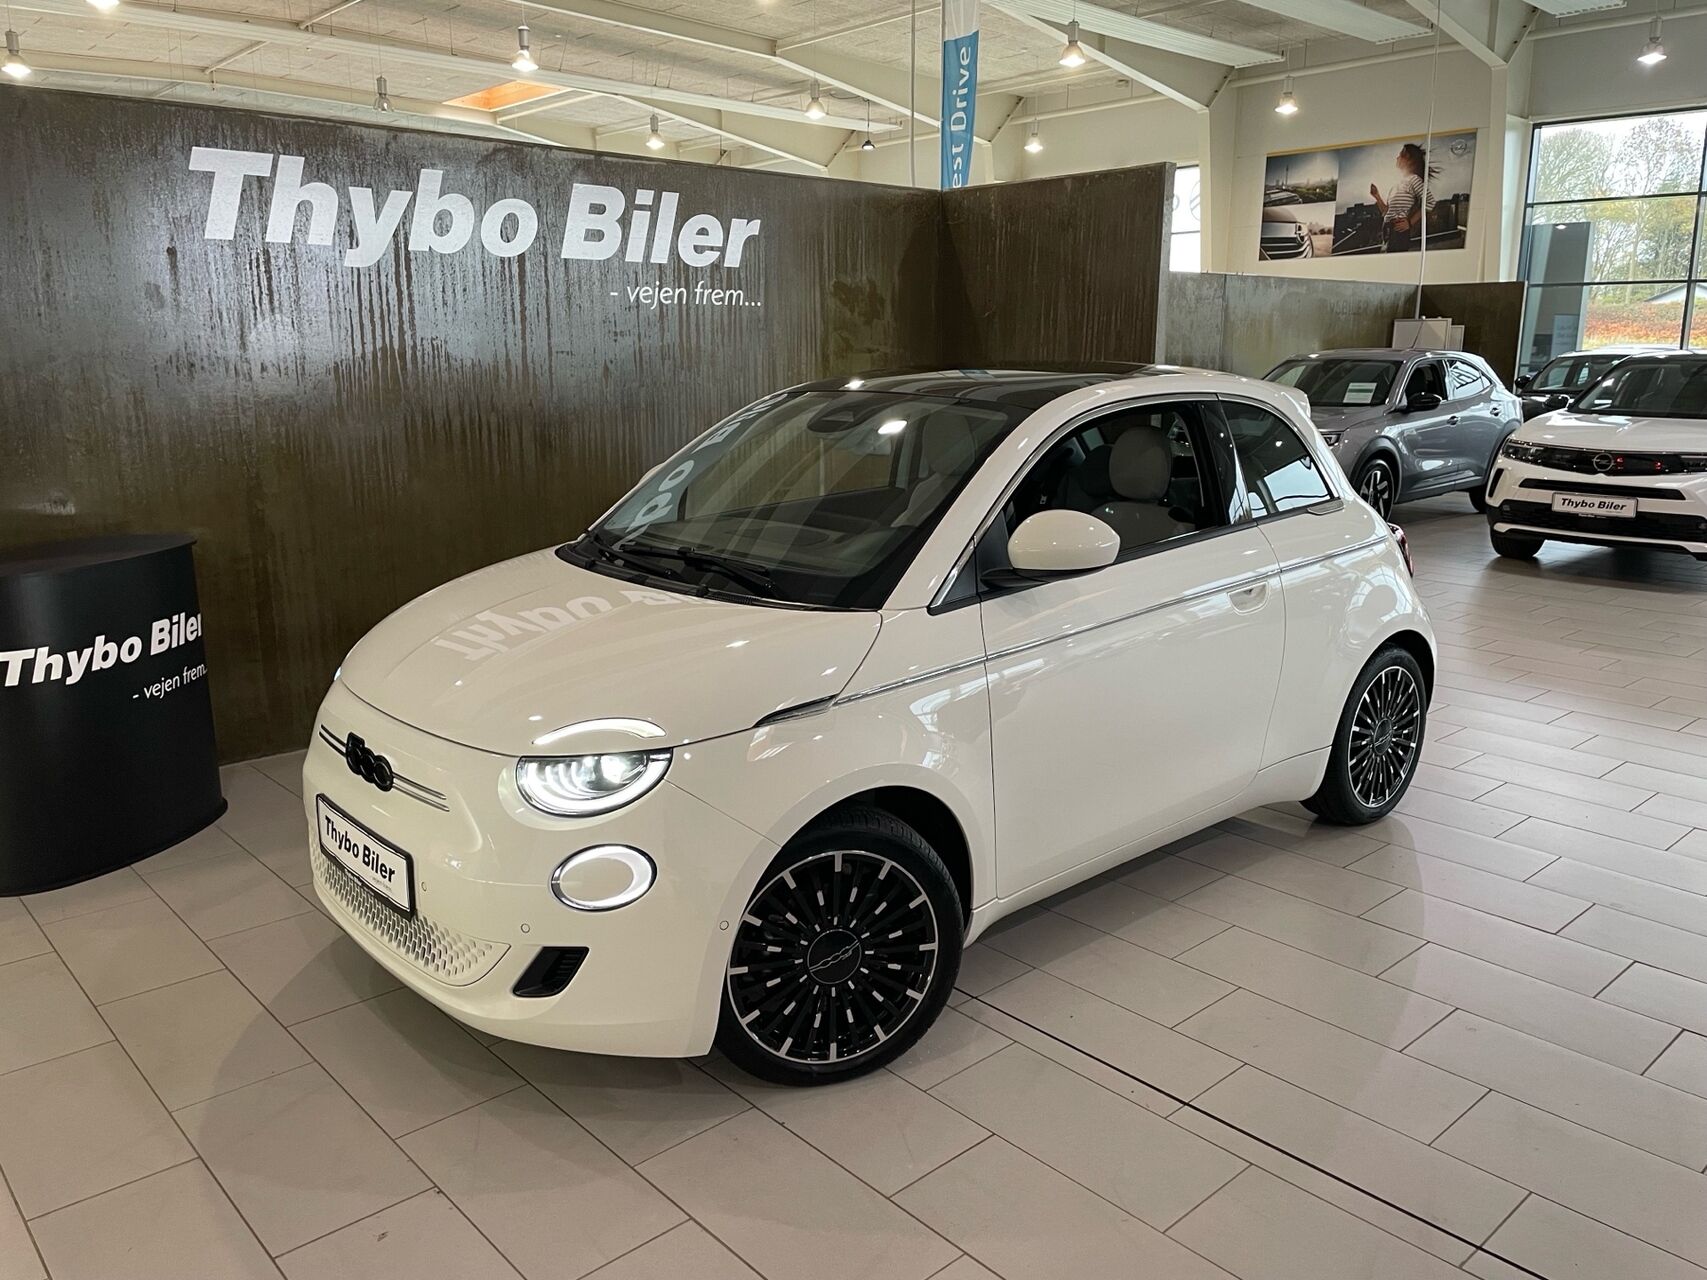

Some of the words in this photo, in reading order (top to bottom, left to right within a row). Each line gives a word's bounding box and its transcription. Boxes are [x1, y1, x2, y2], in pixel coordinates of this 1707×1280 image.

[950, 46, 972, 132] Drive
[951, 143, 965, 189] est
[188, 146, 540, 268] Thybo
[560, 182, 762, 269] Biler
[626, 282, 687, 311] vejen
[694, 281, 763, 307] frem...
[1561, 497, 1595, 509] Thybo
[1597, 500, 1627, 511] Biler
[0, 635, 143, 688] Thybo
[144, 674, 180, 699] vejen
[324, 815, 360, 859] Thybo
[362, 844, 396, 883] Biler
